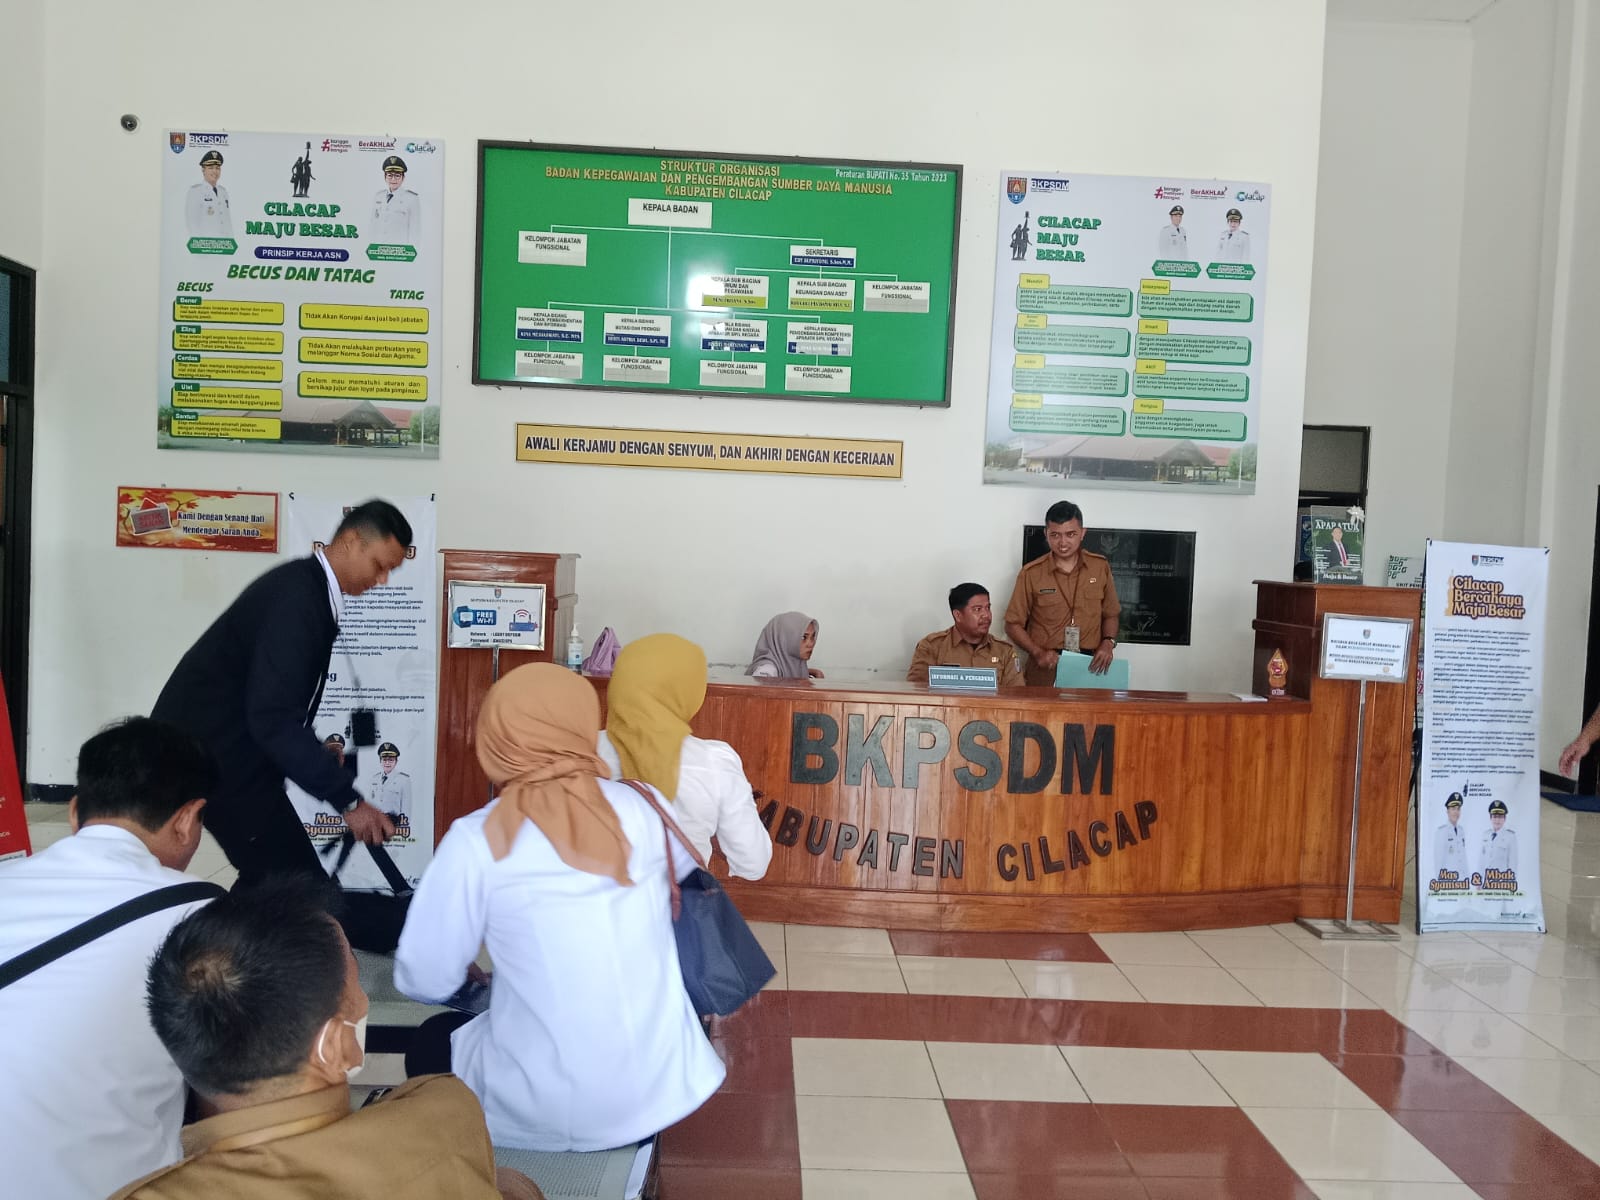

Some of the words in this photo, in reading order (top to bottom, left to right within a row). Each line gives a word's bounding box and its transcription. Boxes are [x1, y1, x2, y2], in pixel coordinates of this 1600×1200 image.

[189, 135, 229, 145] BKPSDM
[358, 140, 396, 149] BerAKHLAK
[660, 160, 716, 173] STRUKTUR
[719, 164, 781, 177] ORGANISASI
[835, 168, 865, 179] Peraturan
[867, 170, 889, 180] BUPATI
[911, 173, 930, 182] Tahun
[931, 174, 948, 182] 2023
[545, 166, 580, 179] BADAN
[583, 168, 658, 183] KEPEGAWAIAN
[661, 173, 682, 184] DAN
[685, 174, 768, 188] PENGEMBANGAN
[771, 178, 813, 191] SUMBER
[816, 180, 841, 192] DAYA
[844, 181, 893, 195] MANUSIA
[1031, 180, 1070, 190] BKPSDM
[665, 185, 726, 199] KABUPATEN
[728, 188, 773, 201] CILACAP
[264, 202, 341, 218] CILACAP
[642, 203, 671, 213] KEPALA
[673, 204, 699, 214] BADAN
[1037, 215, 1102, 230] CILACAP
[246, 221, 297, 238] MAJU
[298, 222, 359, 239] BESAR
[525, 235, 556, 243] KELOMPOK
[557, 237, 582, 245] JABATAN
[1036, 232, 1079, 246] MAJU
[535, 243, 571, 251] FUNGSIONAL
[805, 248, 839, 256] SEKRETARIS
[262, 249, 292, 258] PRINSIP
[293, 249, 322, 259] KERJA
[323, 250, 343, 260] ASN
[1036, 248, 1086, 263] BESAR
[227, 264, 283, 280] BECUS
[284, 266, 320, 281] DAN
[323, 267, 376, 284] TATAG
[177, 282, 214, 292] BECUS
[390, 289, 425, 300] TATAG
[339, 313, 363, 321] Korupsi
[525, 436, 560, 451] AWALI
[563, 437, 617, 453] KERJAMU
[620, 440, 665, 456] DENGAN
[668, 442, 717, 460] SENYUM,
[720, 444, 743, 459] DAN
[744, 446, 783, 461] AKHIRI
[785, 447, 830, 463] DENGAN
[832, 450, 895, 467] KECERIAAN
[177, 511, 196, 520] Kami
[197, 512, 223, 523] Dengan
[224, 513, 249, 523] Senang
[250, 514, 265, 523] Hati
[182, 526, 219, 536] Mendengar
[221, 527, 241, 536] Saran
[242, 528, 260, 537] Anda
[1454, 575, 1504, 594] Cilacap
[1454, 589, 1523, 608] Bercahaya
[1453, 602, 1487, 619] Maju
[1488, 604, 1526, 619] Besar
[790, 712, 1115, 795] BKPSDM
[315, 812, 343, 826] Mas
[753, 790, 964, 879] ABUPATEN
[997, 800, 1158, 882] CILACAP
[1439, 868, 1459, 880] Mas
[1471, 872, 1482, 886] &
[1485, 868, 1516, 881] Mbak
[1429, 879, 1470, 892] Syamsul
